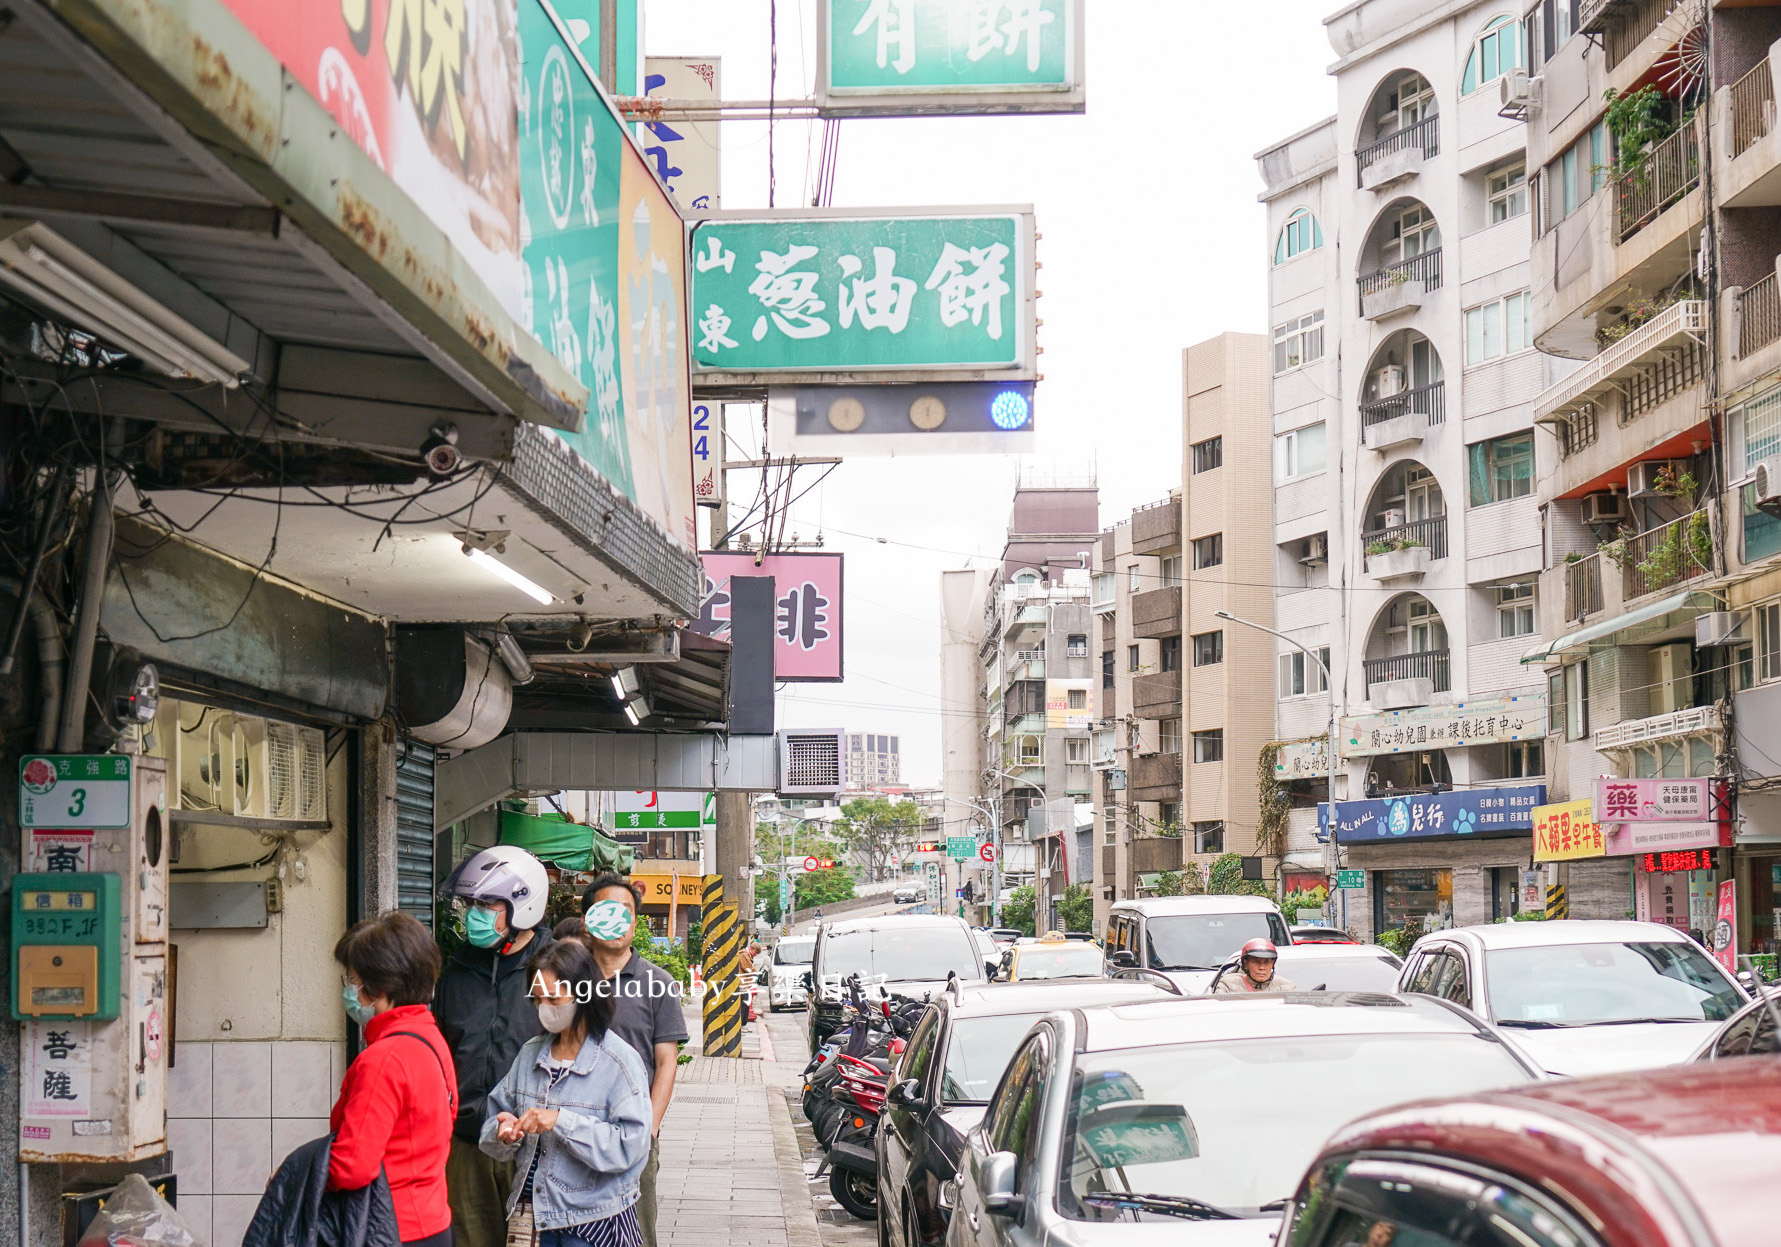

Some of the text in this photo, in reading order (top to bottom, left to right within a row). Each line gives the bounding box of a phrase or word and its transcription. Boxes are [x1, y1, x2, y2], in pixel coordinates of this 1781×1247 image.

[696, 236, 739, 353] 山東
[1475, 704, 1506, 713] Preschool
[1447, 714, 1524, 739] 課後托育中心
[58, 759, 128, 775] 克強路
[24, 796, 35, 824] 士林區
[67, 788, 87, 817] 3
[1606, 784, 1638, 818] 藥
[1663, 795, 1698, 804] 健保藥局
[1340, 811, 1375, 831] ALL IN ALL
[1537, 811, 1602, 854] 大蘋果早午餐
[35, 893, 84, 909] 信箱
